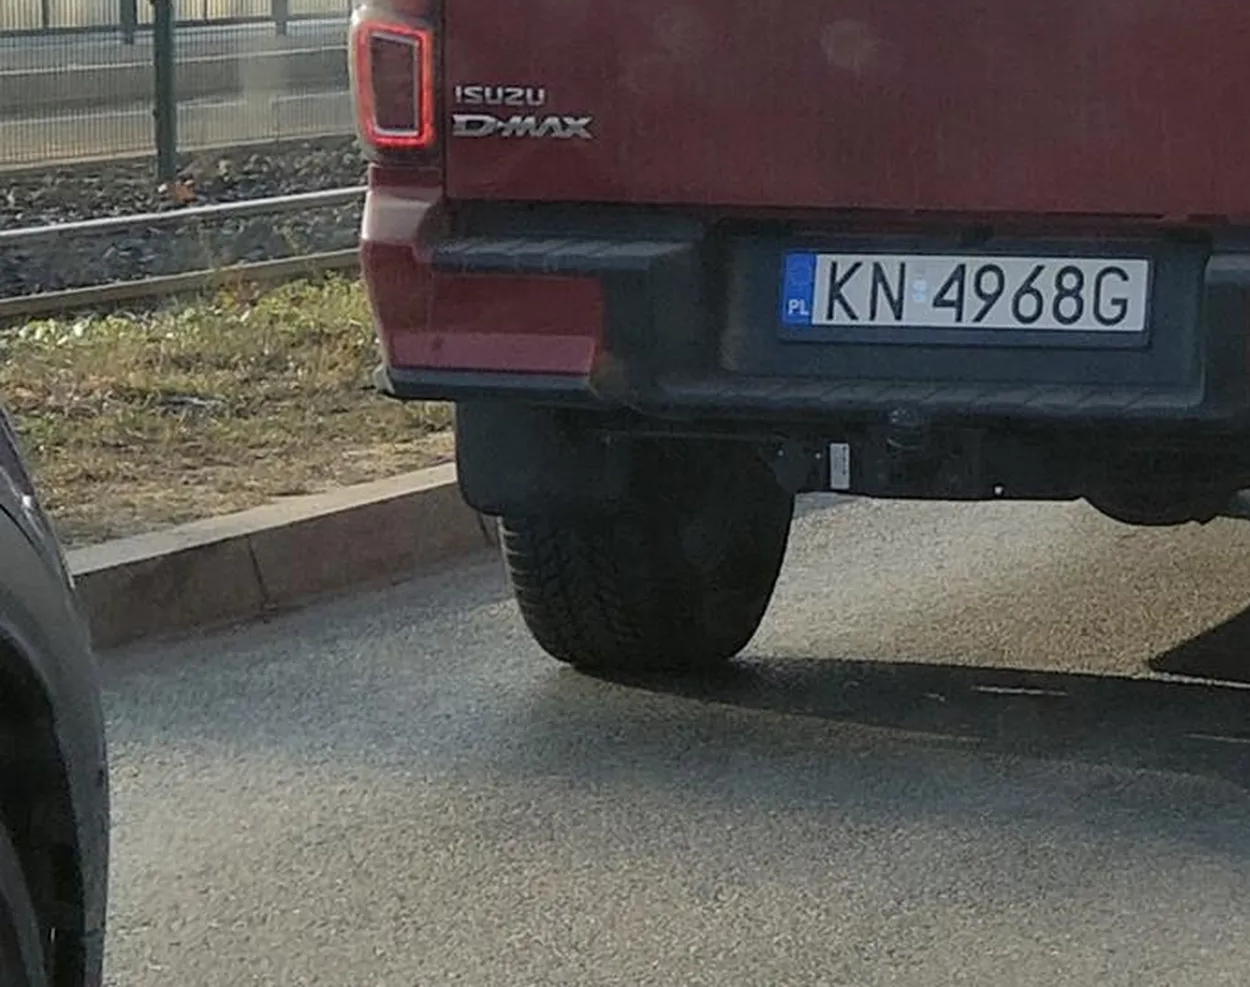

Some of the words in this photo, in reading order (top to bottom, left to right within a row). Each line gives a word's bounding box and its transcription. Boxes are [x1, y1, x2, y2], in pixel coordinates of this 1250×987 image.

[455, 85, 545, 106] ISUZU
[452, 114, 593, 139] D-MAX
[825, 261, 906, 322] KN
[932, 263, 1129, 326] 4968G
[788, 298, 810, 316] PL
